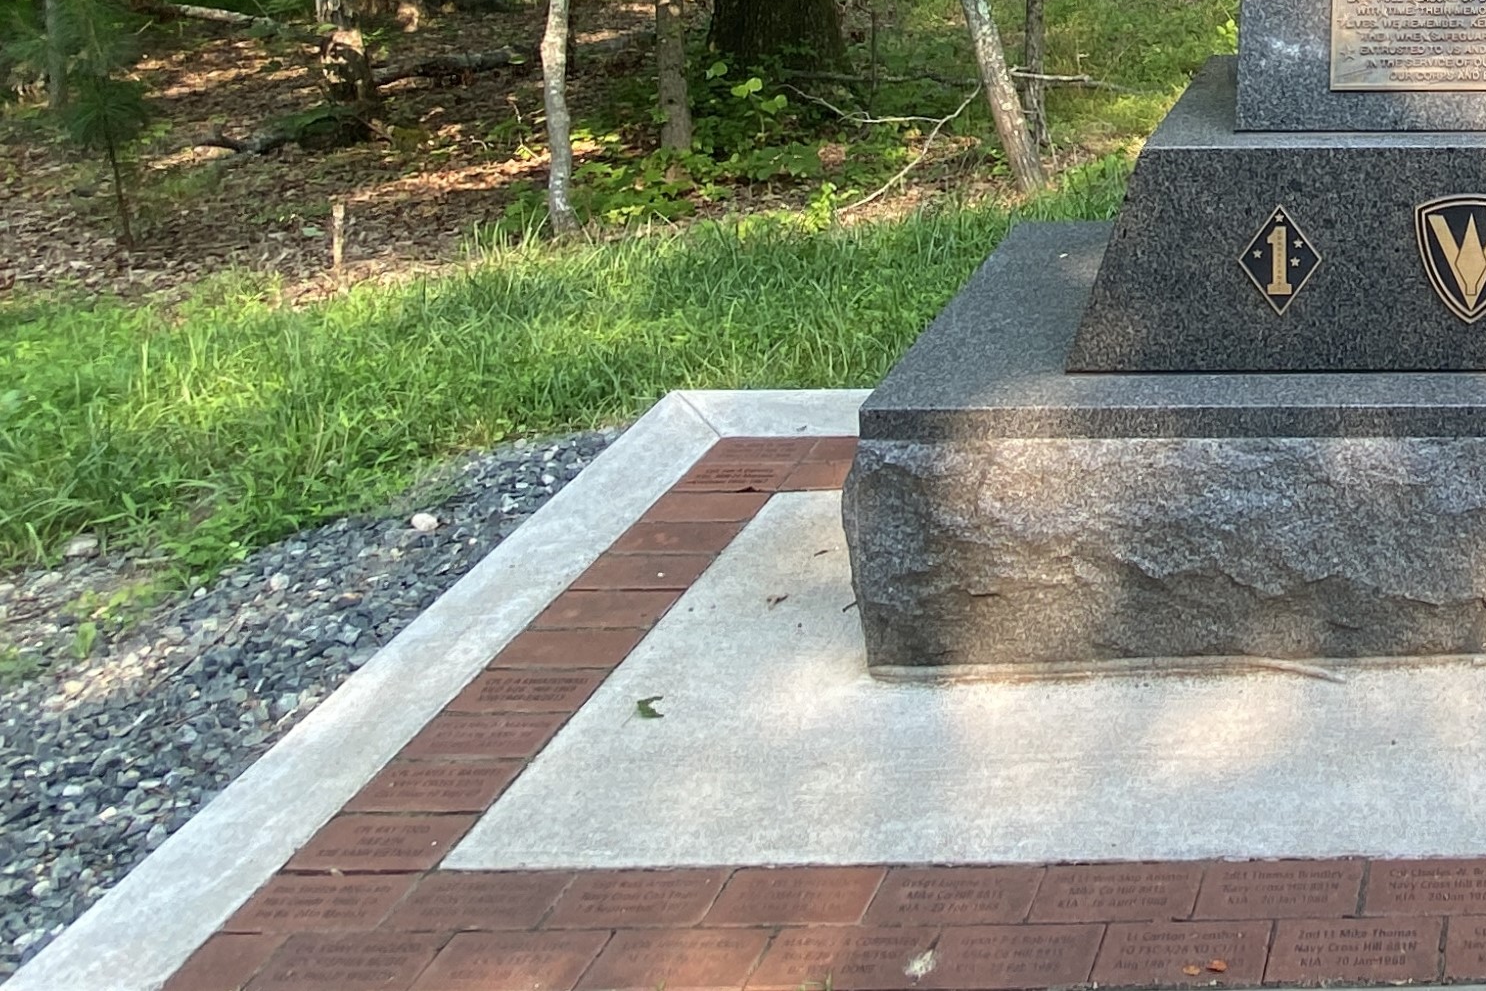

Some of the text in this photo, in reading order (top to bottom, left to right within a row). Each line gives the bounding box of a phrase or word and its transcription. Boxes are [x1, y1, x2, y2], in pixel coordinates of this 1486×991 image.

[1356, 6, 1381, 17] WITH
[1417, 6, 1450, 17] THEIR
[1382, 19, 1400, 30] WE
[1360, 45, 1425, 56] ENTRUSTED
[1427, 45, 1444, 56] TO
[1446, 45, 1461, 56] US
[1380, 58, 1402, 69] THE
[1404, 58, 1454, 69] SERVICE
[1455, 58, 1474, 68] OF
[1389, 71, 1414, 82] OUR
[1416, 71, 1455, 82] CORPS
[1457, 71, 1480, 82] AND
[1267, 226, 1292, 295] 1
[1339, 928, 1368, 938] Mike
[1371, 928, 1418, 938] Thomas
[1294, 942, 1323, 954] Navy
